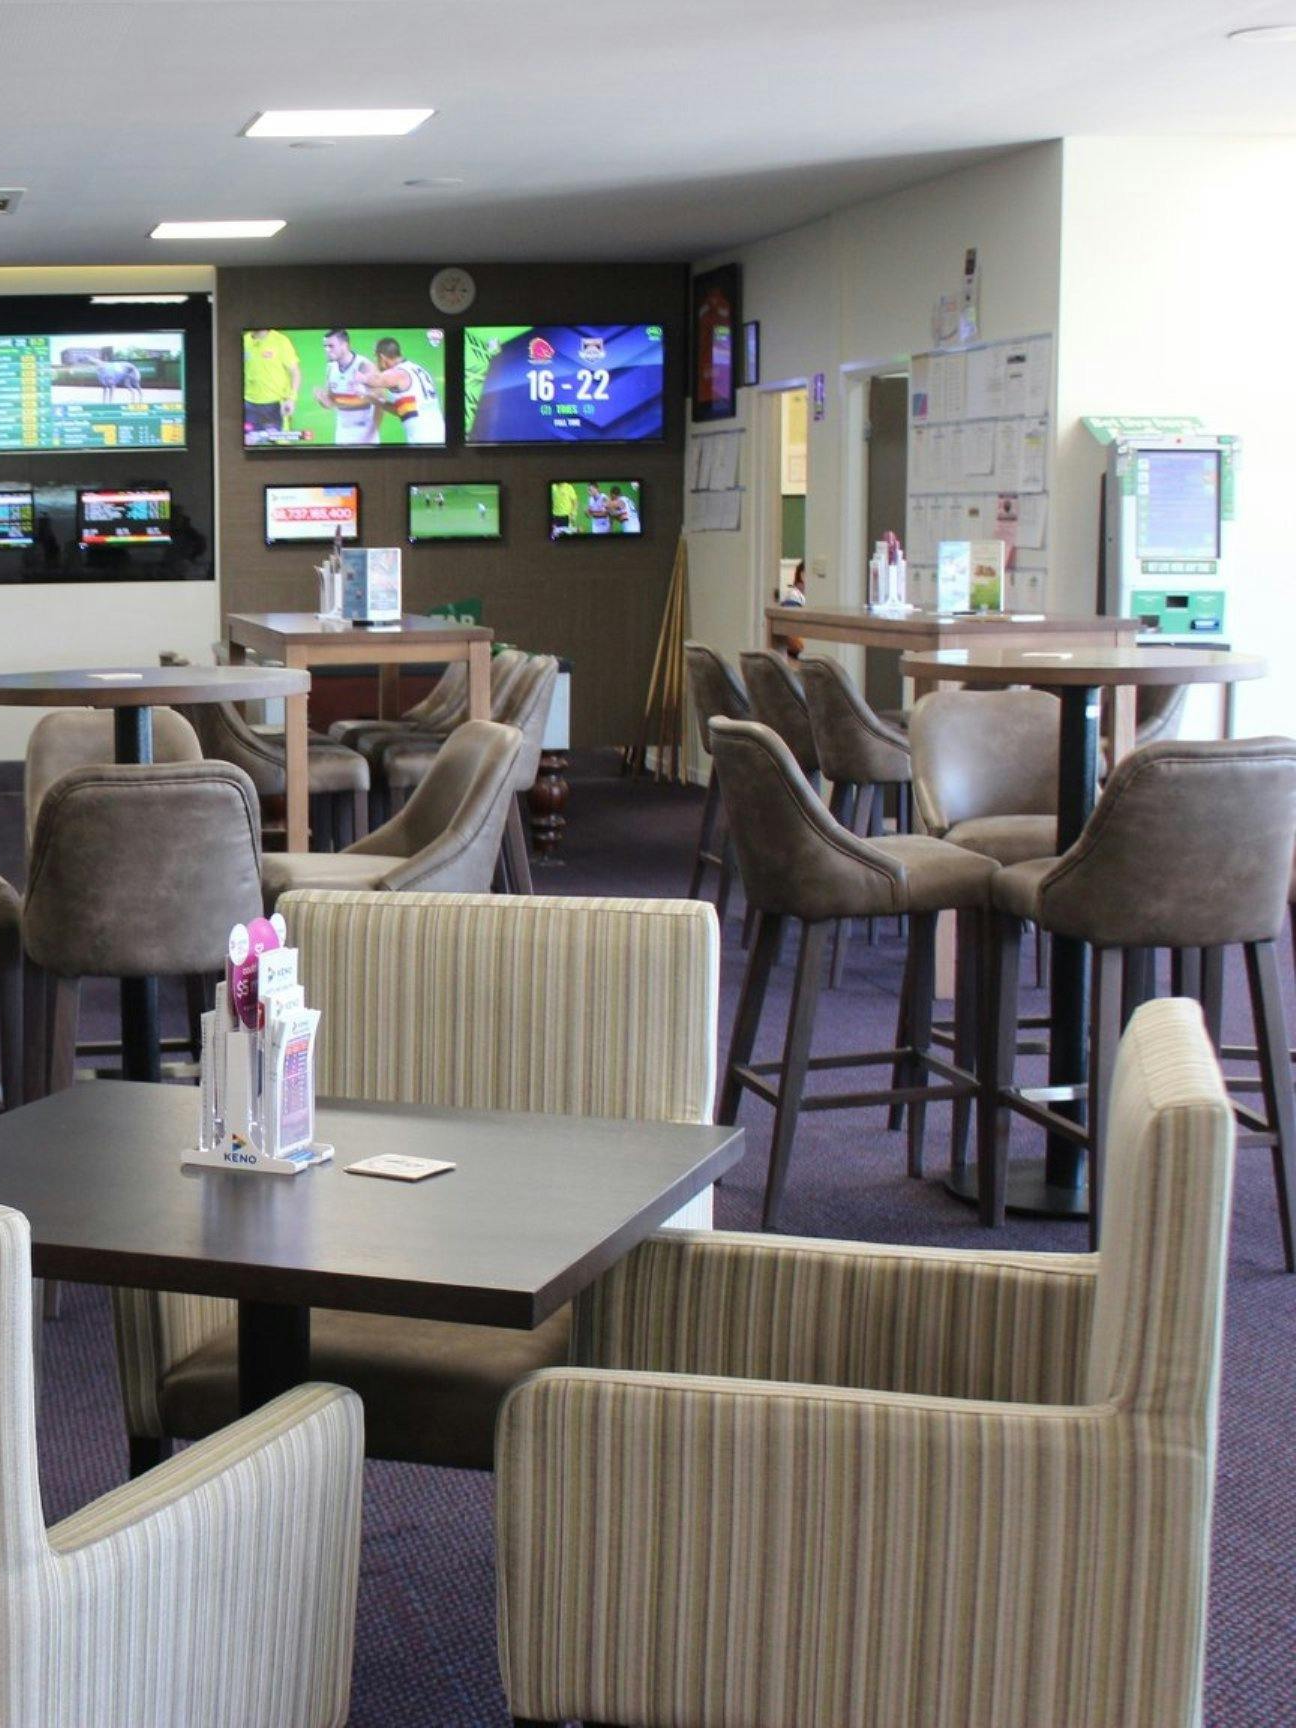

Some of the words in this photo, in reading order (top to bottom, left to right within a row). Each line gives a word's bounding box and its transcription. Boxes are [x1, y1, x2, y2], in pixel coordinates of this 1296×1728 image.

[526, 369, 555, 401] 16
[576, 369, 610, 401] 22
[224, 1152, 257, 1165] KENO
